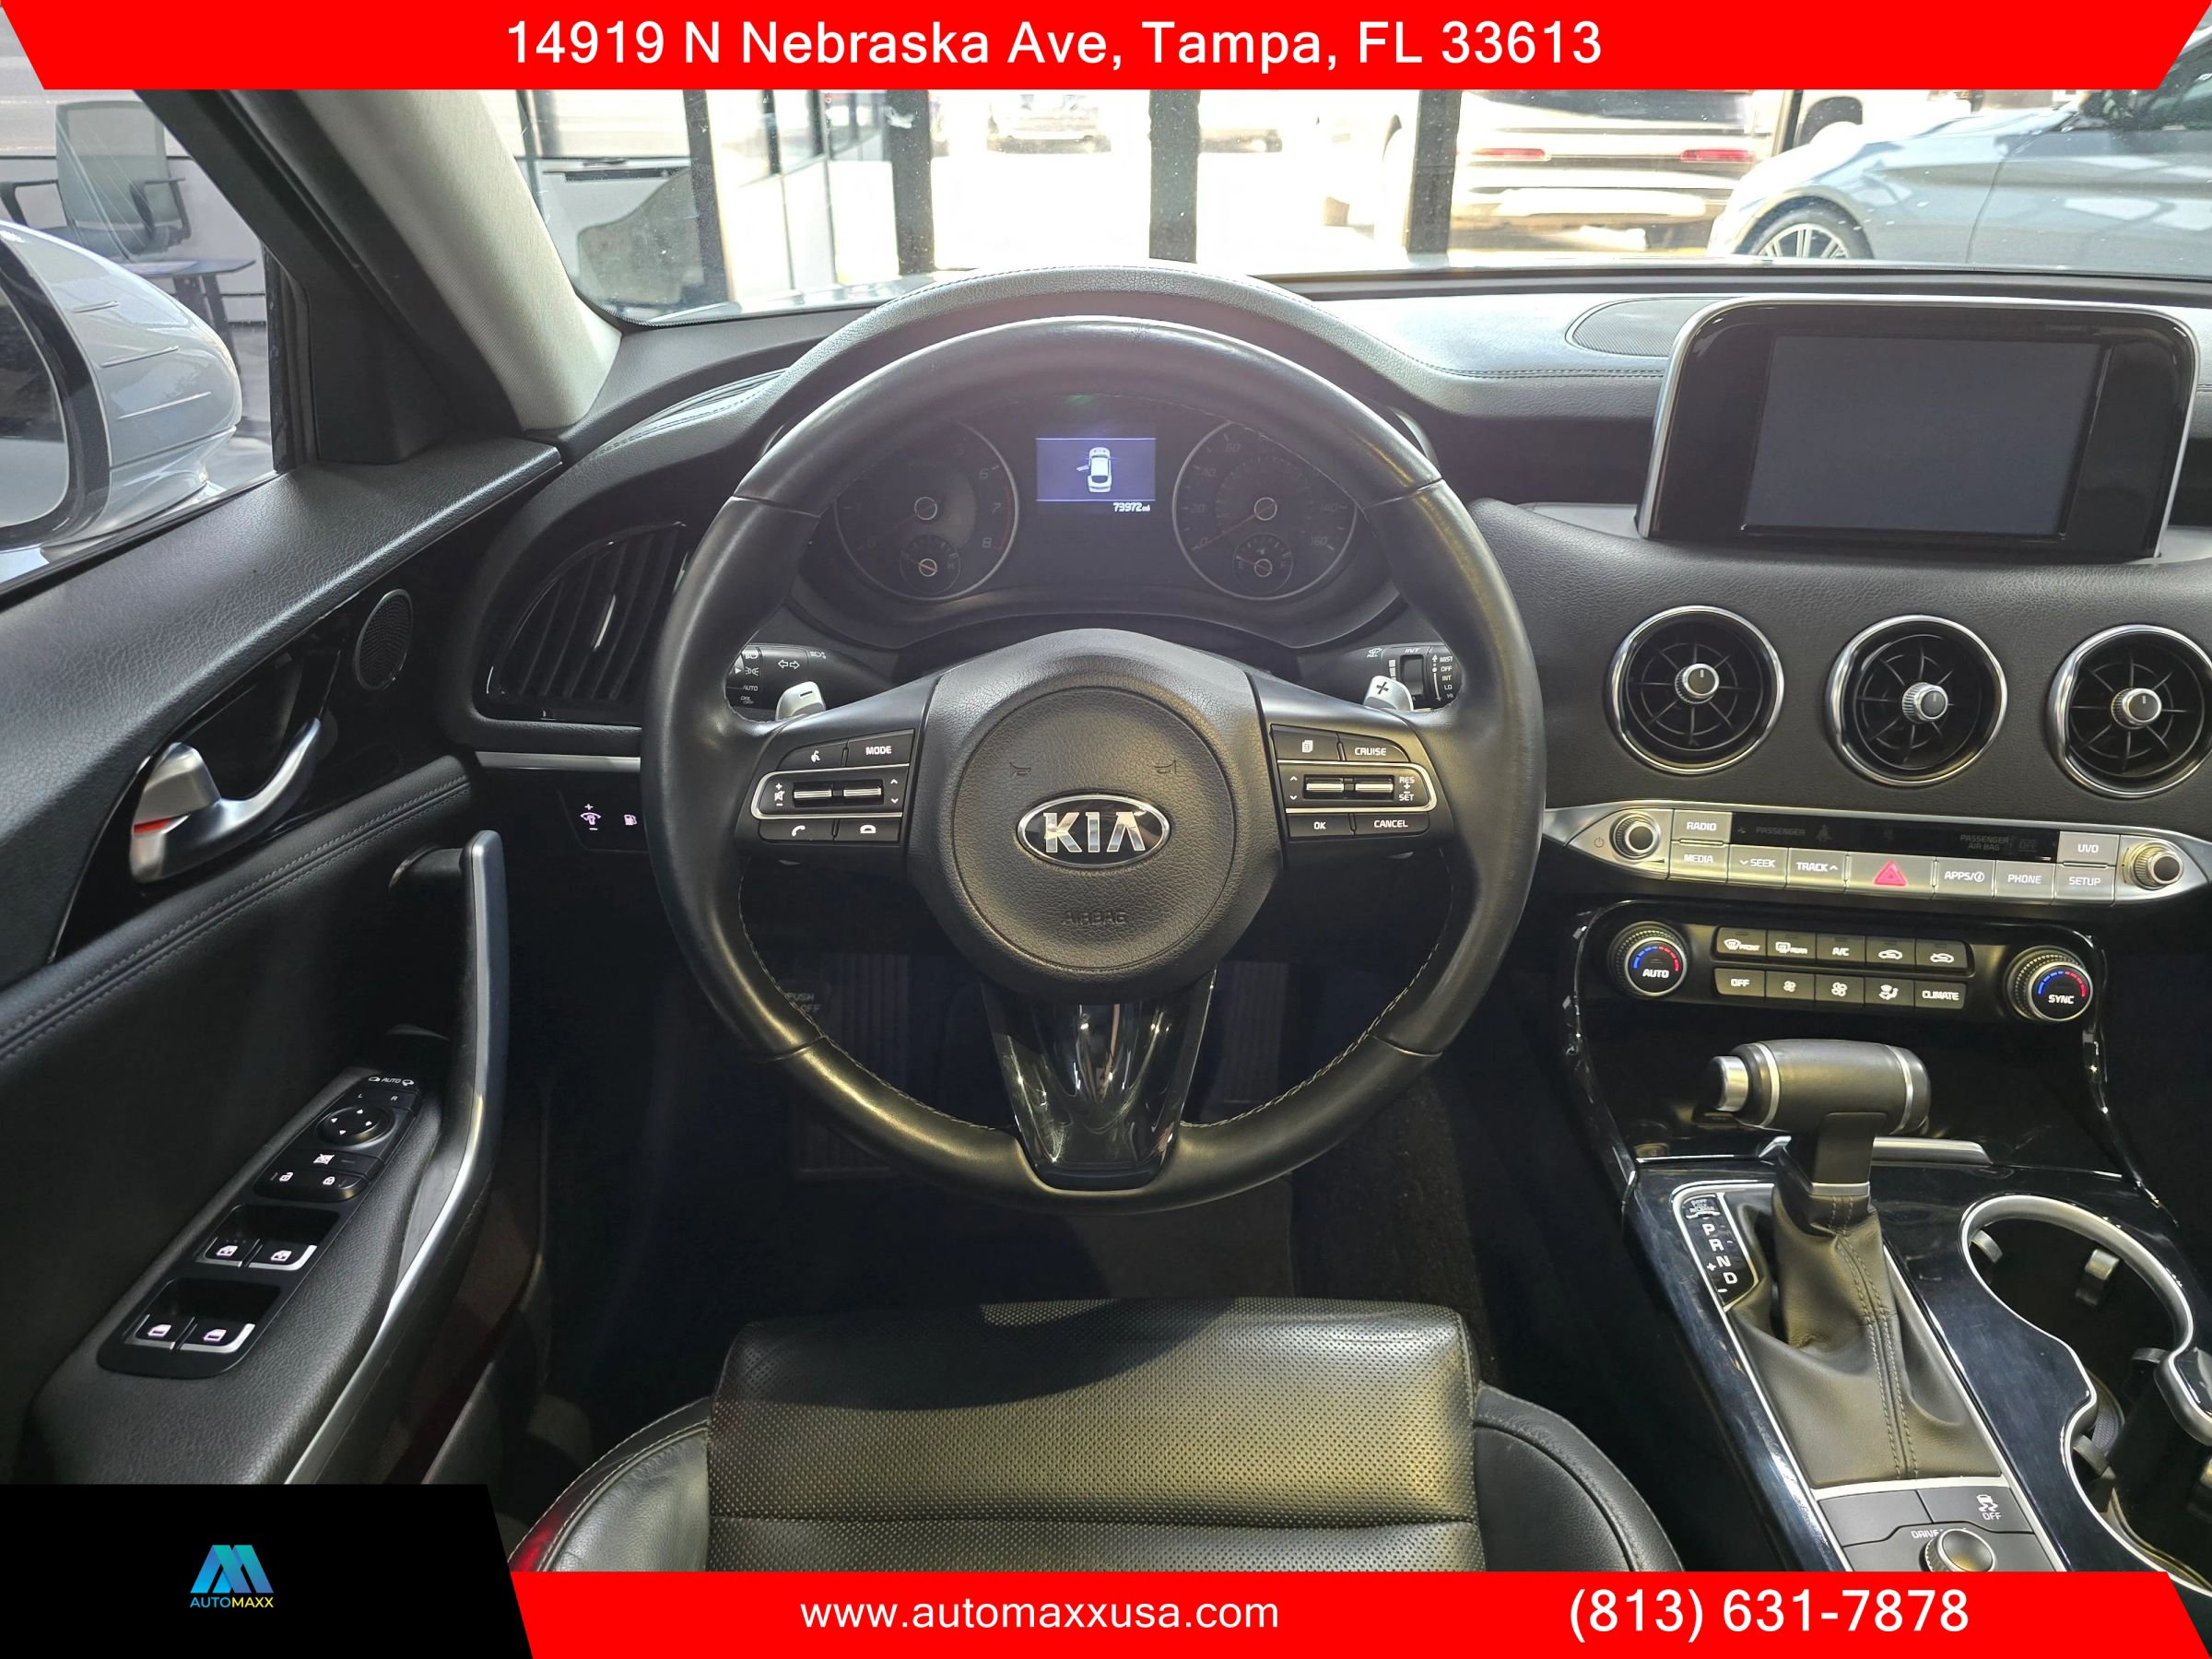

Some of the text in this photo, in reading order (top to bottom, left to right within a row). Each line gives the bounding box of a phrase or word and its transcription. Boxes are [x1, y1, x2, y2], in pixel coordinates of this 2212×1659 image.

[979, 468, 989, 480] 6
[992, 502, 1002, 514] 7
[982, 537, 993, 548] 8
[865, 746, 892, 756] MODE
[1354, 747, 1387, 757] CRUISE
[1398, 776, 1416, 784] RES
[1398, 794, 1415, 802] SET
[1313, 820, 1326, 830] OK
[1373, 819, 1409, 829] CANCEL
[1686, 821, 1718, 832] RADIO
[1042, 811, 1146, 853] KIA
[1959, 834, 2010, 844] PASSENGER
[1968, 842, 2000, 852] AIR BAG
[2077, 843, 2100, 853] UVO
[1683, 853, 1714, 865] MEDIA
[1749, 858, 1777, 868] SEEK
[1795, 861, 1829, 872] TRACK
[2007, 874, 2042, 885] PHONE
[2068, 877, 2101, 887] SETUP
[1832, 946, 1850, 957] A/C
[1642, 968, 1670, 979] AUTO
[1730, 978, 1750, 987] OFF
[1922, 990, 1960, 1001] CLIMATE
[2048, 994, 2076, 1005] SYNC
[1701, 1223, 1715, 1236] P
[1708, 1238, 1724, 1252] R
[1715, 1254, 1732, 1267] N
[1723, 1271, 1738, 1285] D
[1982, 1512, 2002, 1521] OFF
